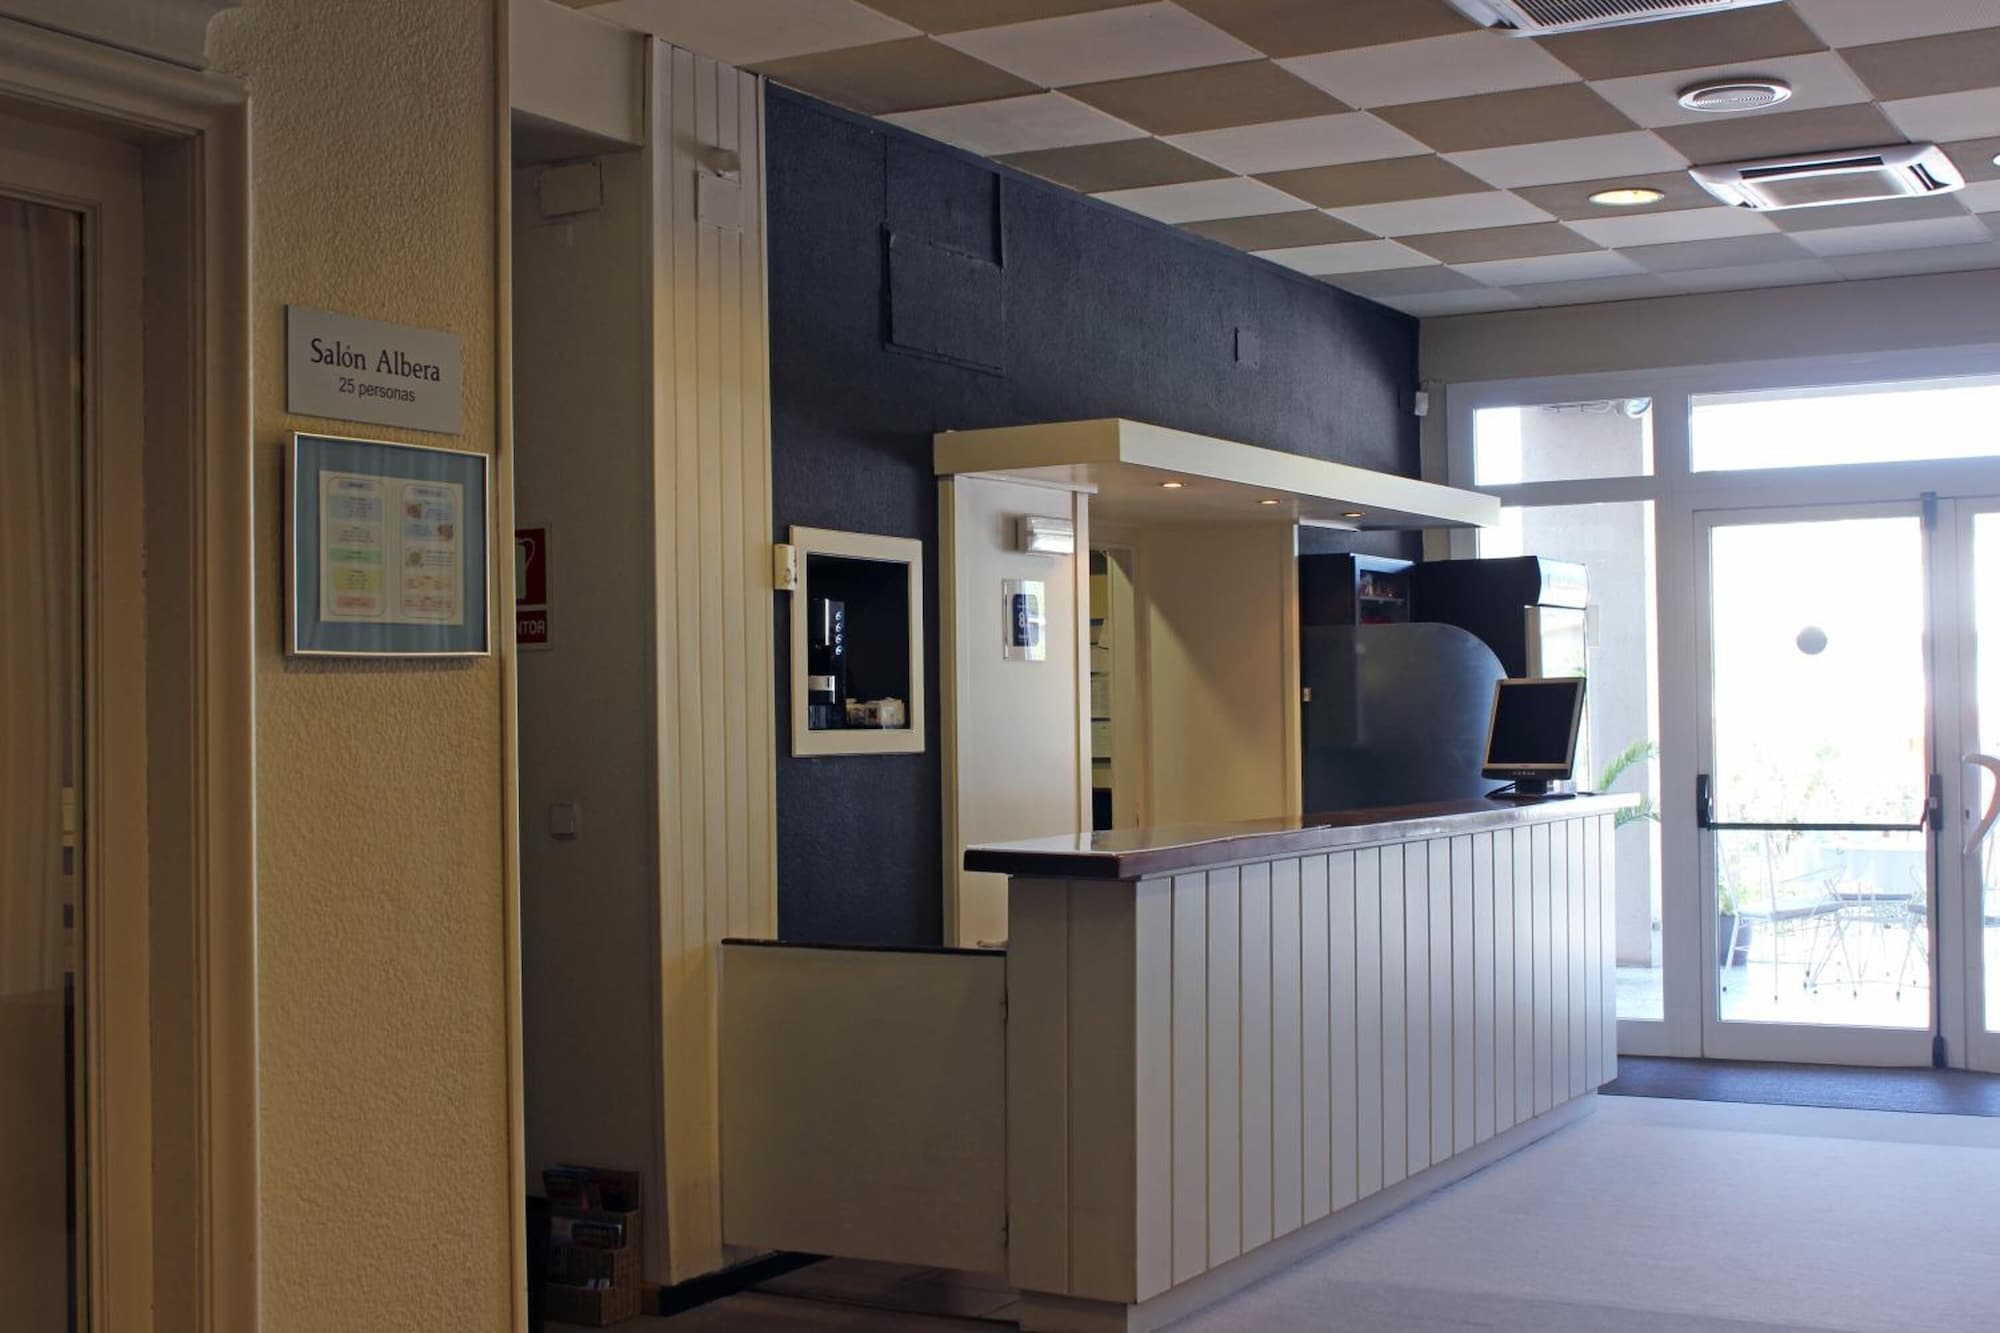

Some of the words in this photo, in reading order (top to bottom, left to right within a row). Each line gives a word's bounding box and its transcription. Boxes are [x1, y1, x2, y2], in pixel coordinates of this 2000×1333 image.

[311, 337, 366, 370] Salón
[376, 349, 440, 382] Albera
[339, 376, 355, 393] 25
[358, 382, 415, 402] personas
